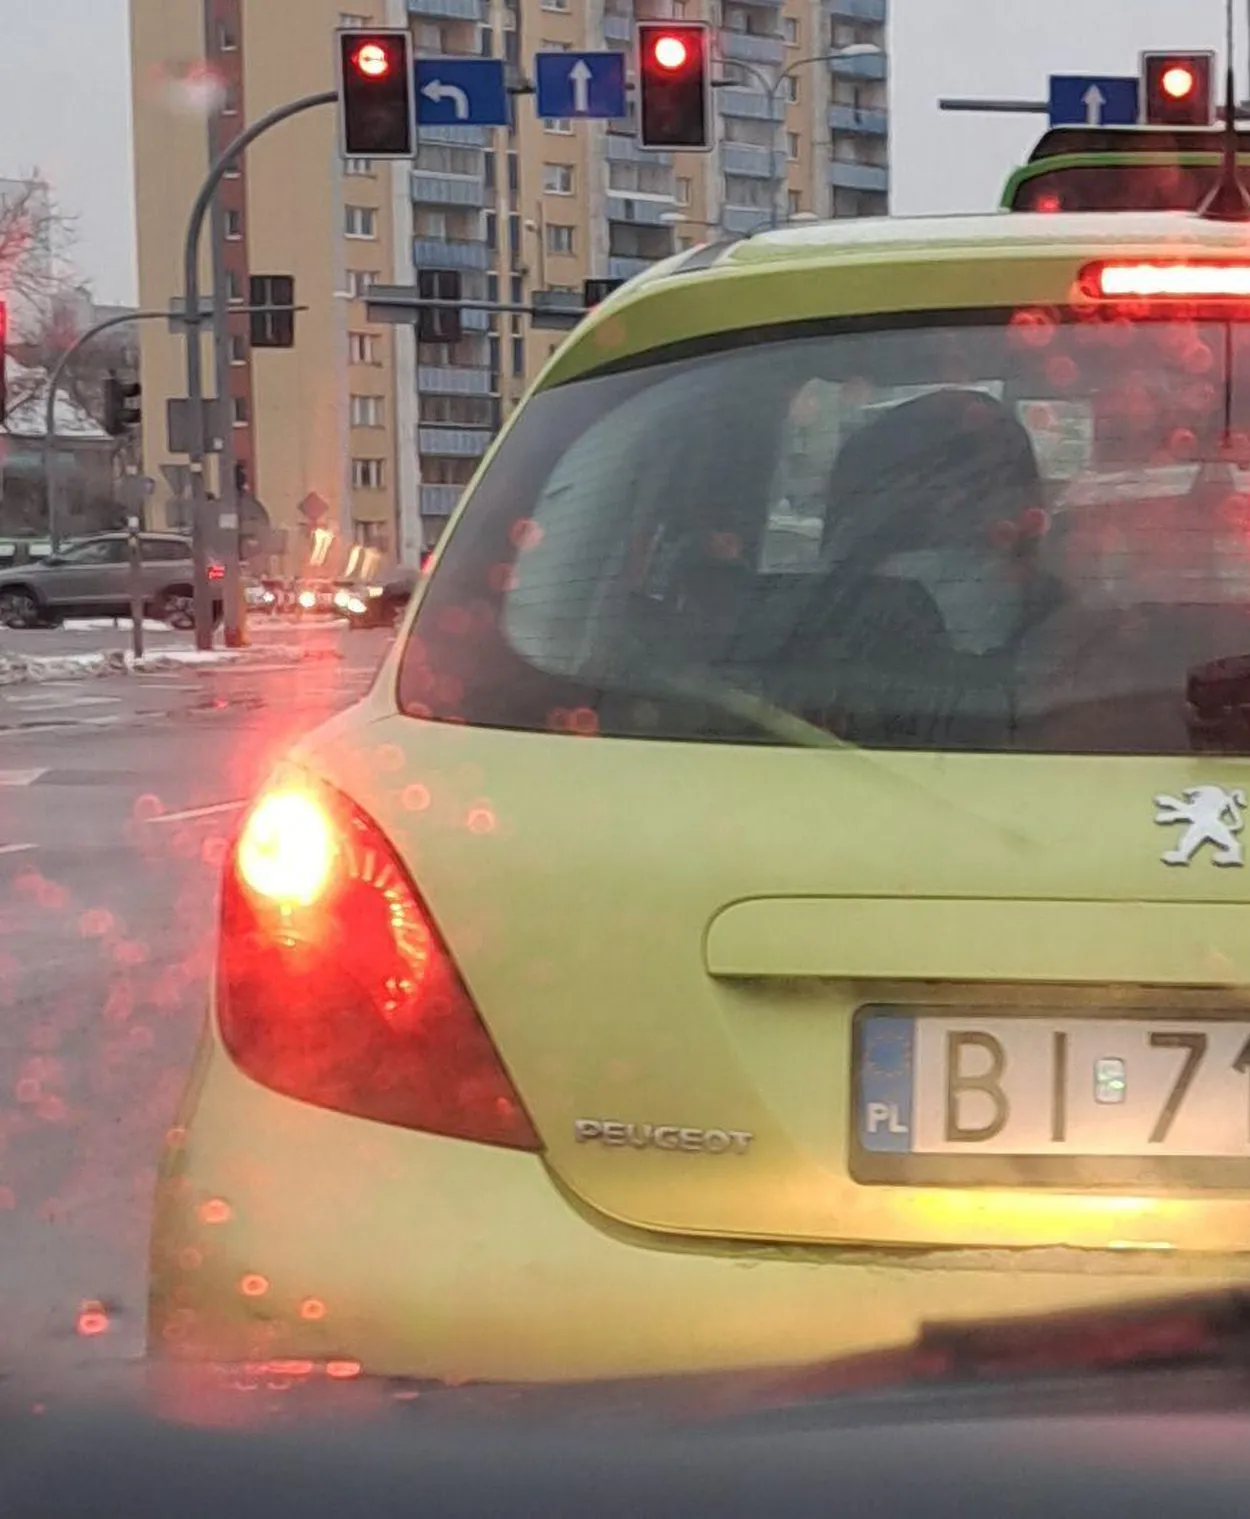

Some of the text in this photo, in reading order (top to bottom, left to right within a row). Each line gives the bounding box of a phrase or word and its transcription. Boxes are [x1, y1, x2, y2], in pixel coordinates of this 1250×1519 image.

[944, 1030, 1067, 1143] BI
[574, 1118, 754, 1155] PEUGEOT
[866, 1101, 908, 1135] PL
